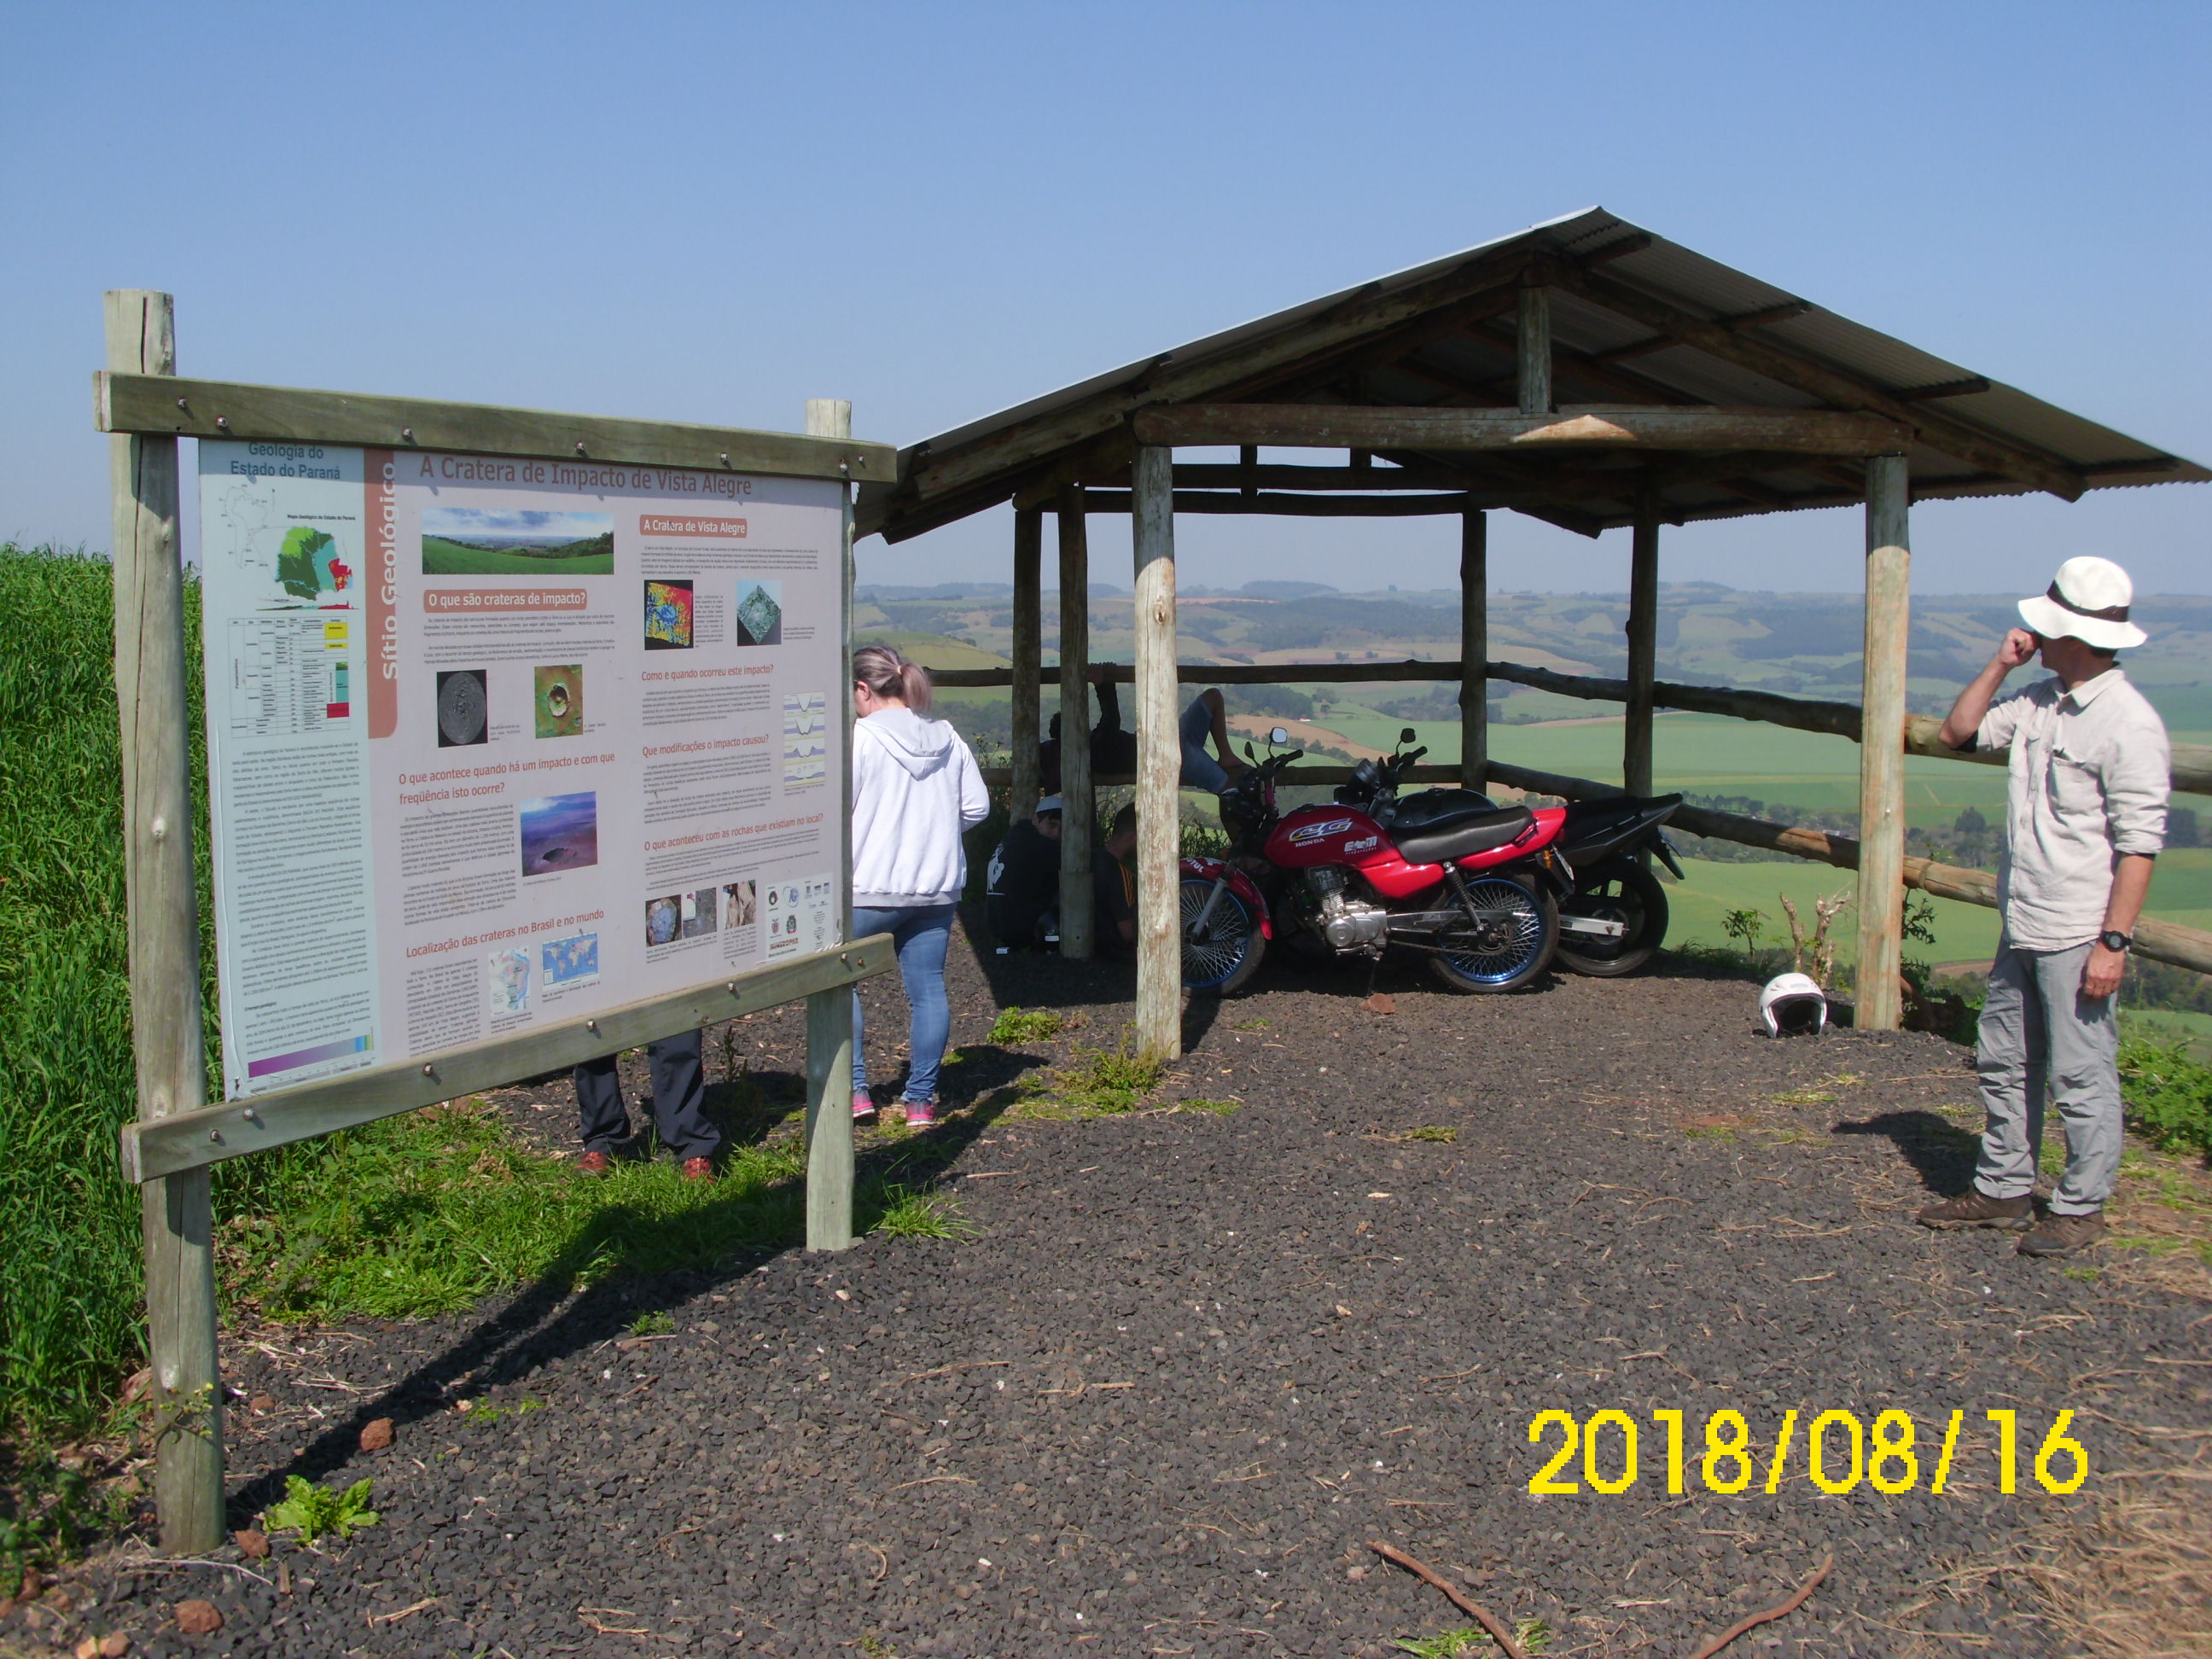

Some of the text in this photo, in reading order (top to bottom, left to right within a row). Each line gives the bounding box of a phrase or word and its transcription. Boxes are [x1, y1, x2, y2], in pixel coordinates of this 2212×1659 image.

[248, 442, 324, 461] Geologia do
[230, 461, 341, 480] Estado do Paraná
[420, 456, 752, 498] A Cratera de Impacto de Vista Alegre
[643, 519, 746, 535] A Cratera de Vista Alegre
[379, 463, 399, 679] Sítio Geológico
[429, 591, 585, 608] O que são crateras de impacto?
[642, 664, 774, 682] Como e quando ocorreu este impacto?
[643, 734, 769, 758] Que modificações o impacto causou?
[399, 752, 615, 785] O que acontece quando há um impacto e com que
[399, 783, 505, 806] freqüência isto ocorre?
[644, 813, 824, 852] O que aconteceu com as rochas que existiam no local?
[1289, 818, 1353, 842] CG
[1295, 837, 1324, 847] HONDA
[406, 909, 604, 958] Localização das crateras no Brasil e no mundo
